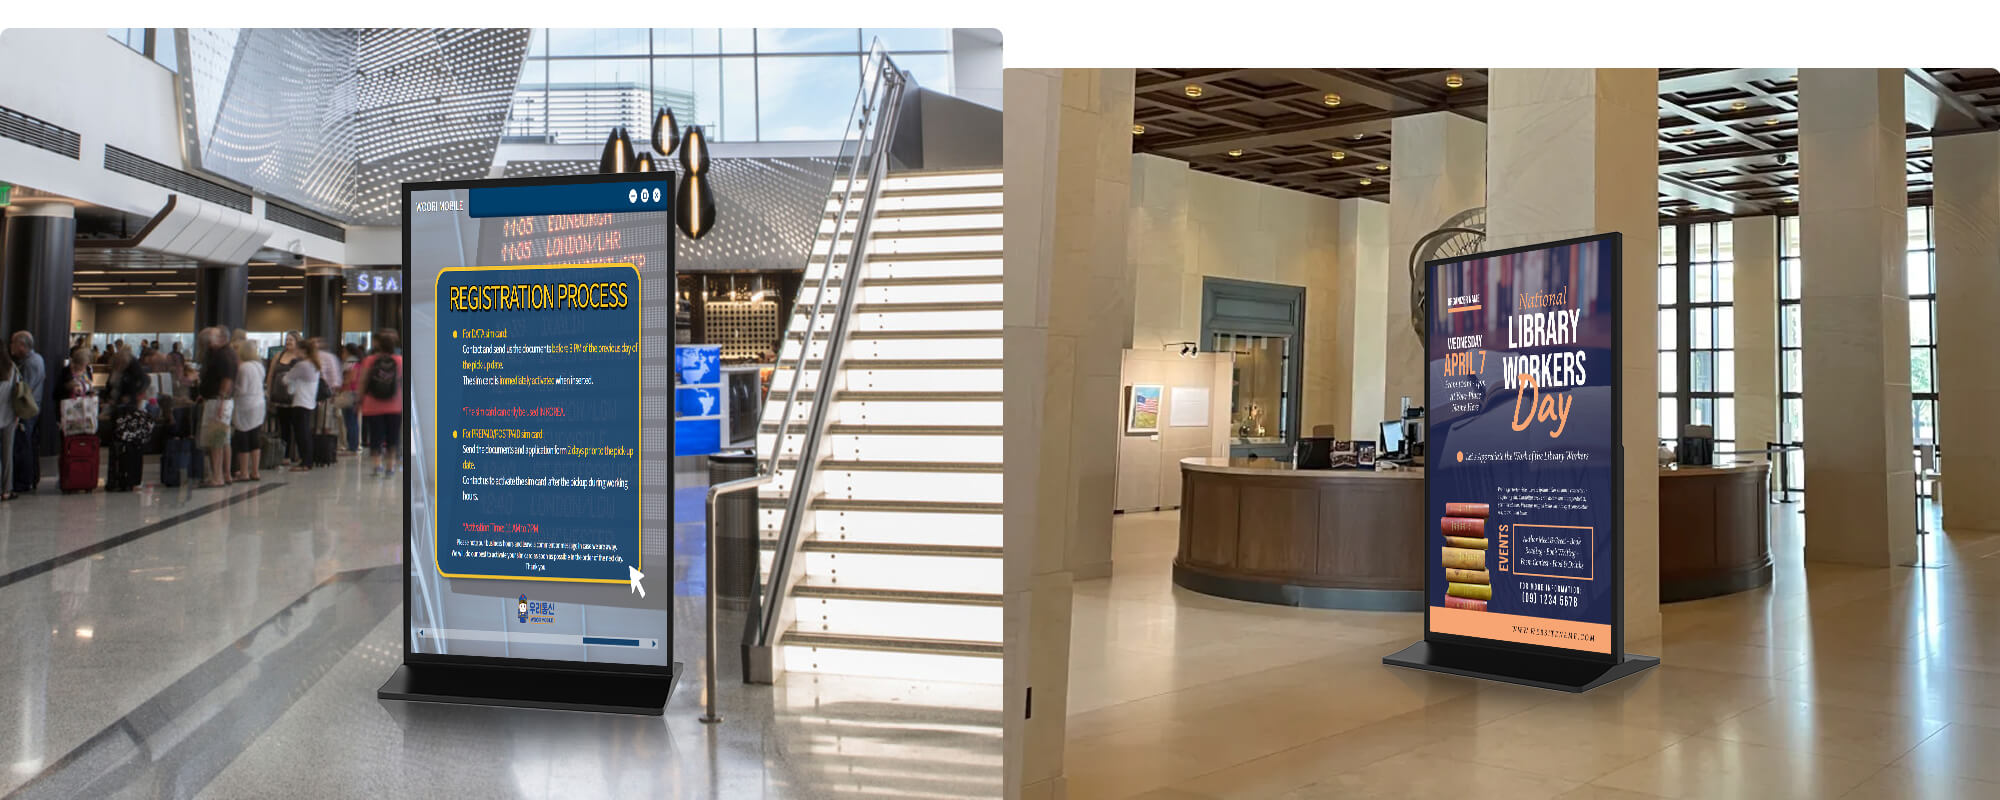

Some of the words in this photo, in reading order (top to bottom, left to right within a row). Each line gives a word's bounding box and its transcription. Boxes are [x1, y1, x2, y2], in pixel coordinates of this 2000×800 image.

[416, 201, 438, 212] WOORI
[439, 200, 464, 211] MOBILE
[546, 231, 621, 257] LONDON/LHR
[358, 274, 402, 291] SEA
[450, 284, 554, 311] REGISTRATION
[558, 282, 628, 309] PROCESS
[1519, 285, 1567, 310] National
[1508, 308, 1580, 349] LIBRARY
[463, 345, 482, 354] Contact
[482, 345, 493, 354] and
[493, 345, 505, 354] send
[507, 346, 512, 354] us
[512, 345, 522, 354] the
[522, 345, 551, 354] documents
[583, 343, 588, 353] of
[589, 343, 597, 353] the
[599, 343, 620, 353] previous
[622, 343, 631, 356] day
[632, 342, 639, 353] of
[1448, 335, 1482, 350] WEDNESDAY
[463, 360, 471, 369] the
[491, 360, 503, 369] date.
[1444, 352, 1476, 376] APRIL
[1479, 350, 1487, 374] 7
[1502, 350, 1587, 390] WORKERS
[463, 376, 472, 385] The
[473, 376, 482, 385] sim
[483, 376, 495, 385] card
[500, 376, 531, 387] immediately
[531, 376, 554, 385] activated
[556, 376, 570, 384] when
[476, 407, 484, 417] sim
[485, 406, 497, 417] card
[497, 407, 507, 417] can
[526, 406, 538, 417] used
[1512, 373, 1573, 438] Day
[521, 429, 530, 439] sim
[463, 445, 475, 454] Send
[476, 445, 485, 454] the
[485, 445, 514, 454] documents
[514, 445, 524, 454] and
[525, 445, 553, 458] application
[554, 445, 567, 455] form
[571, 445, 584, 457] days
[604, 445, 613, 455] the
[1543, 450, 1564, 463] Library
[463, 460, 475, 469] date.
[463, 476, 482, 485] Contact
[482, 477, 489, 485] us
[490, 477, 495, 485] to
[495, 476, 515, 486] activate
[515, 476, 524, 486] the
[524, 476, 534, 486] sim
[535, 476, 547, 486] card
[548, 476, 560, 487] after
[560, 476, 569, 487] the
[588, 477, 606, 490] during
[607, 477, 628, 490] working
[463, 490, 478, 500] hours.
[1499, 524, 1509, 572] EVENTS
[1519, 582, 1529, 590] FOR
[1530, 583, 1543, 591] MORE
[1539, 594, 1557, 605] 1234
[1560, 595, 1578, 607] 5678
